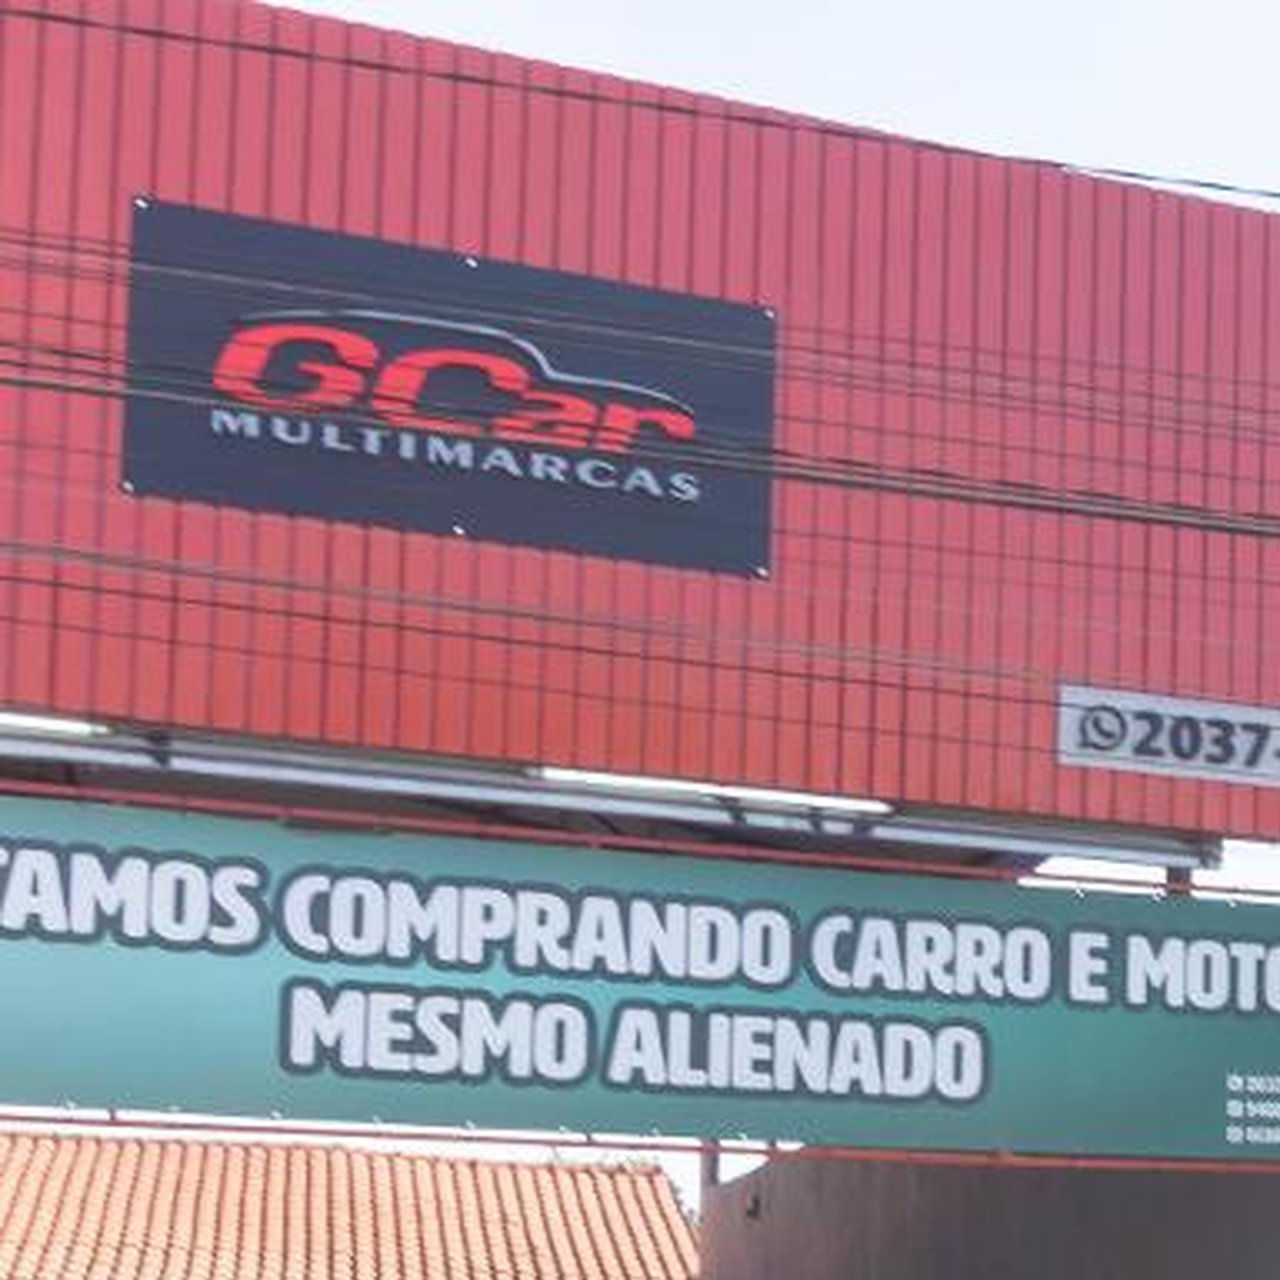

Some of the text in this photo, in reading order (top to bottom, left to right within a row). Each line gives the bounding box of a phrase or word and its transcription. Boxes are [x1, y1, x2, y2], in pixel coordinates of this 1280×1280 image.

[211, 408, 701, 501] MULTIMARCAS
[0, 847, 261, 945] AMOS
[283, 873, 792, 984] COMPRANDO
[812, 914, 1052, 1001] CARRO
[1069, 931, 1110, 1003] E
[290, 986, 984, 1099] MESMO ALIENADO
